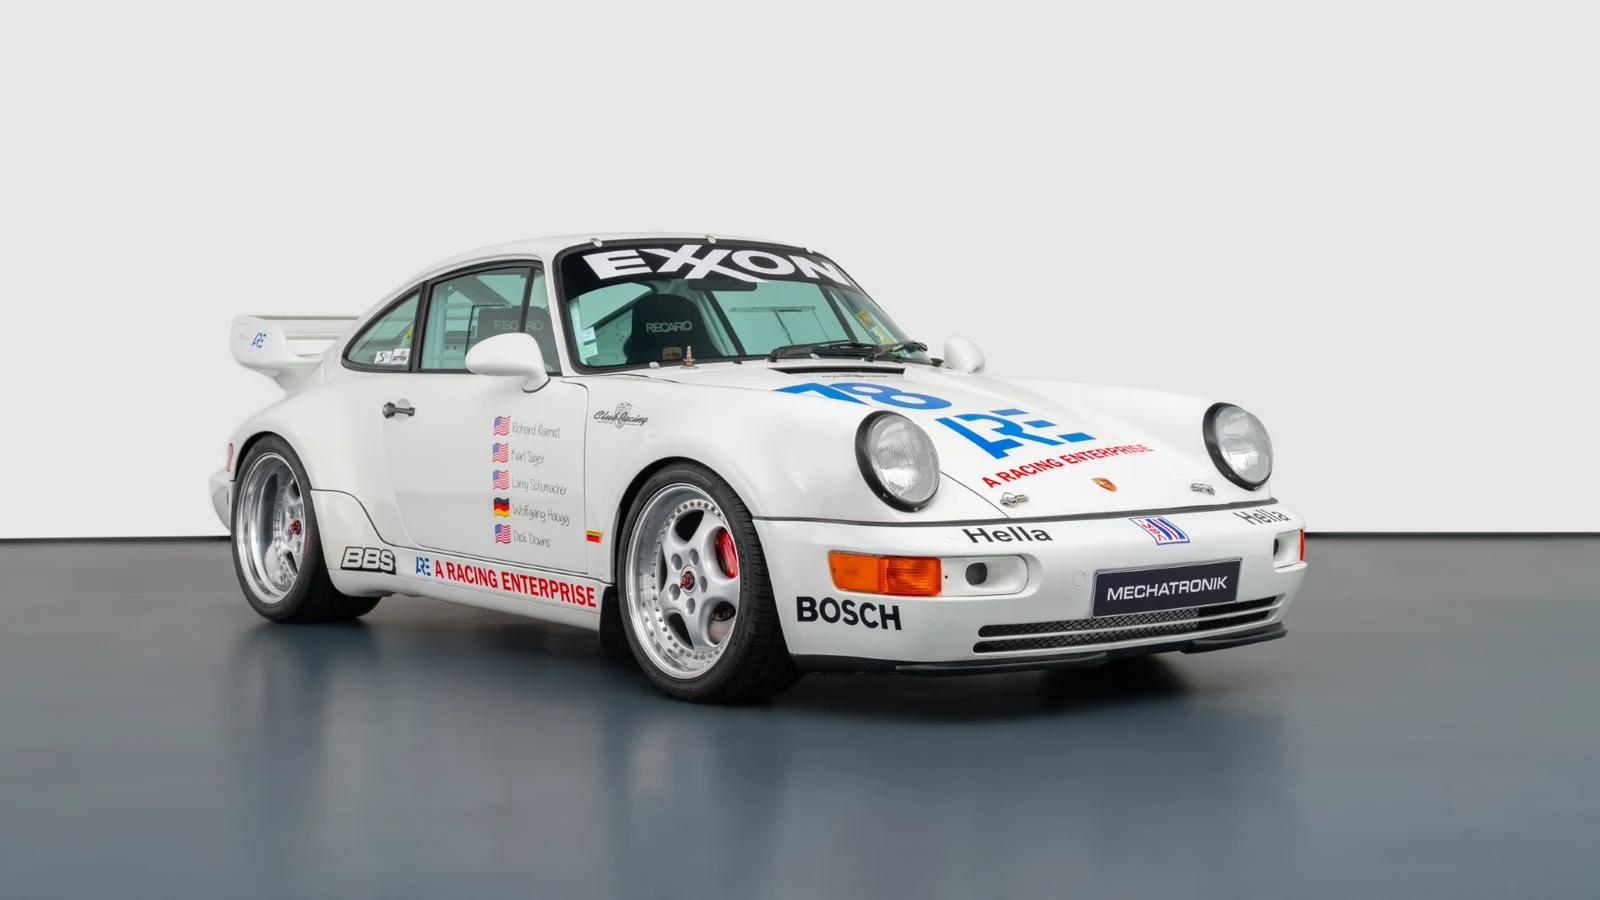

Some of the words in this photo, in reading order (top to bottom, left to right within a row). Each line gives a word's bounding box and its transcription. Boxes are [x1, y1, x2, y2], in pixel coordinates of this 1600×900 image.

[583, 245, 852, 286] EXXON
[493, 319, 544, 331] RECRO
[645, 320, 692, 333] RECARO
[773, 382, 952, 410] 78
[511, 421, 536, 435] Richard
[511, 449, 525, 462] Karl
[981, 476, 1002, 489] A
[996, 457, 1063, 482] RACING
[1061, 443, 1155, 465] ENTERPRISE
[511, 476, 528, 492] Larry
[530, 478, 567, 495] Schumacher
[512, 503, 545, 522] Wolfgang
[1233, 508, 1292, 525] Hella
[513, 530, 527, 543] Dick
[961, 526, 1054, 544] Hella
[340, 546, 396, 575] BBS
[435, 559, 444, 579] A
[446, 561, 498, 589] RACING
[501, 571, 597, 608] ENTERPRISE
[1107, 575, 1229, 602] MECHATRONIK
[796, 596, 903, 631] BOSCH
